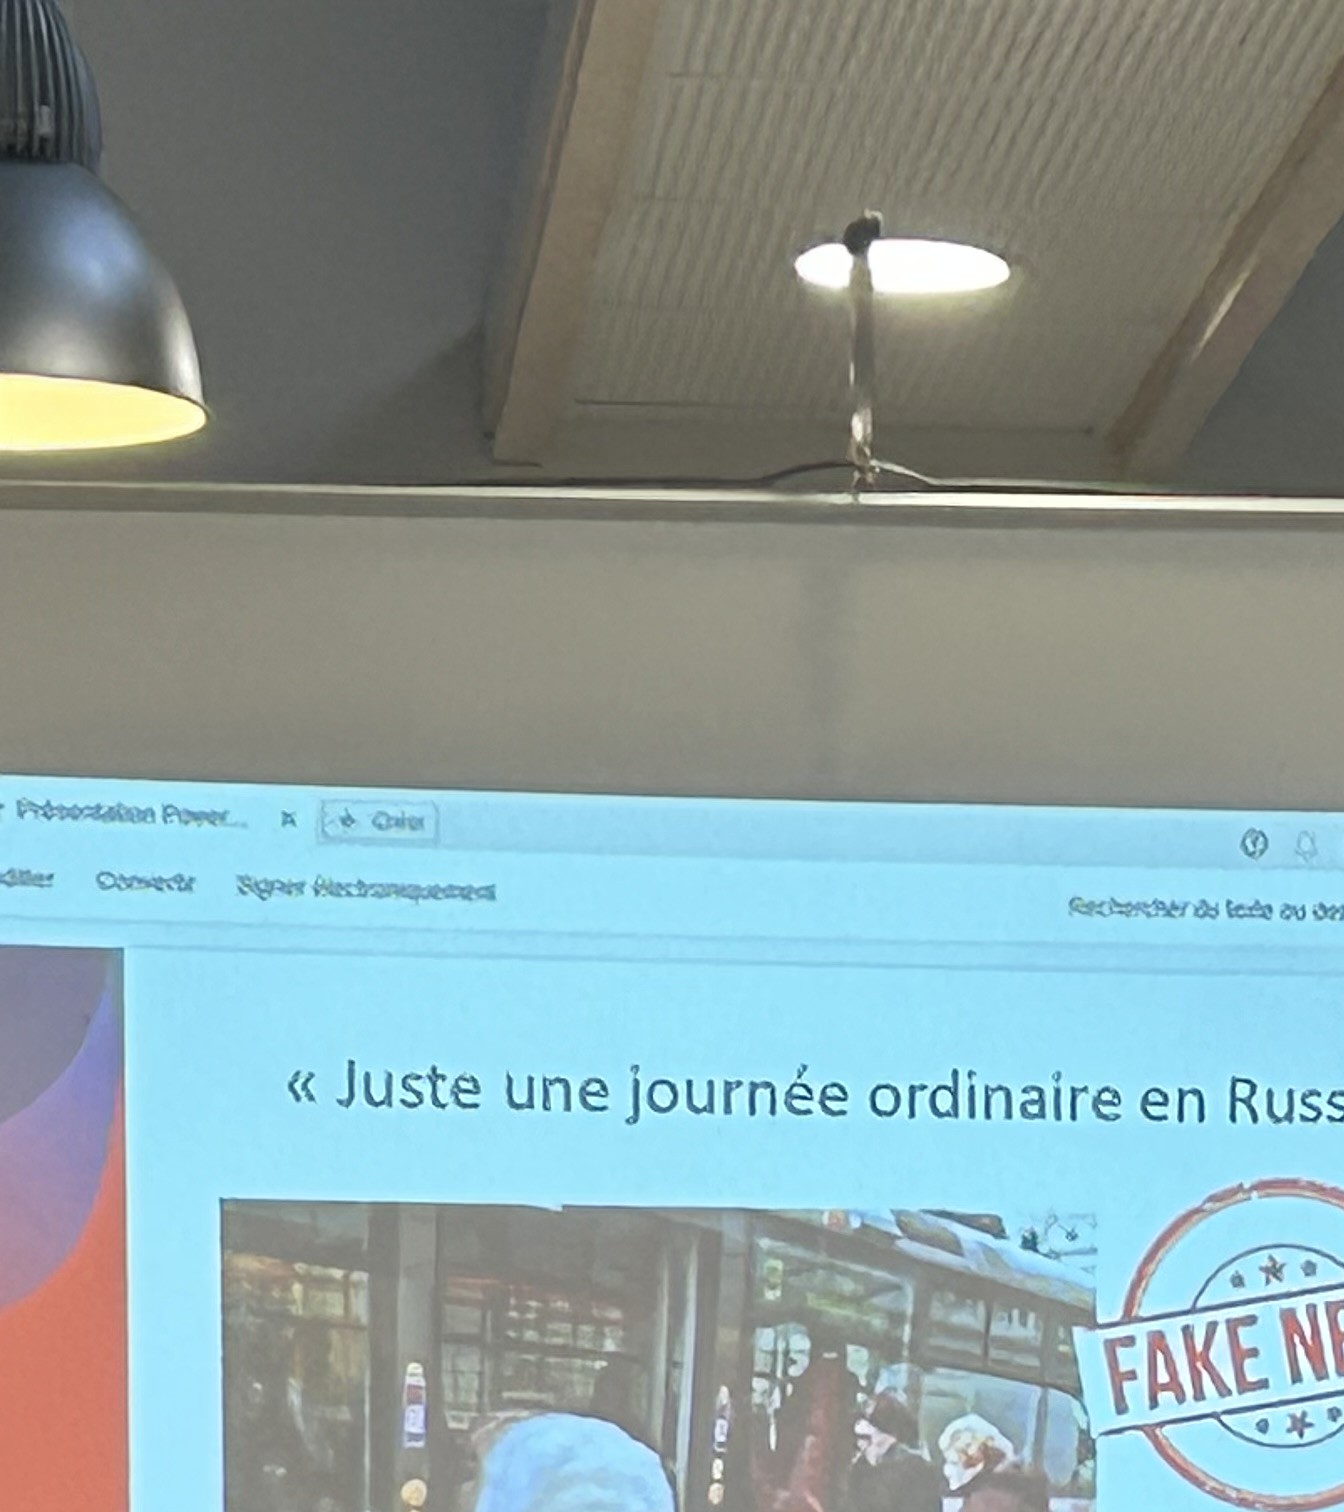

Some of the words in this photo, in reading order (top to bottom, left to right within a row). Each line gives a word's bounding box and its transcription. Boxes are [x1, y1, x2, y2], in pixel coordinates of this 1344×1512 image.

[337, 1059, 482, 1111] Juste
[505, 1069, 609, 1113] une
[625, 1062, 849, 1126] journée
[869, 1068, 1122, 1123] ordinaire
[1140, 1085, 1207, 1125] en
[1102, 1312, 1270, 1417] FAKE
